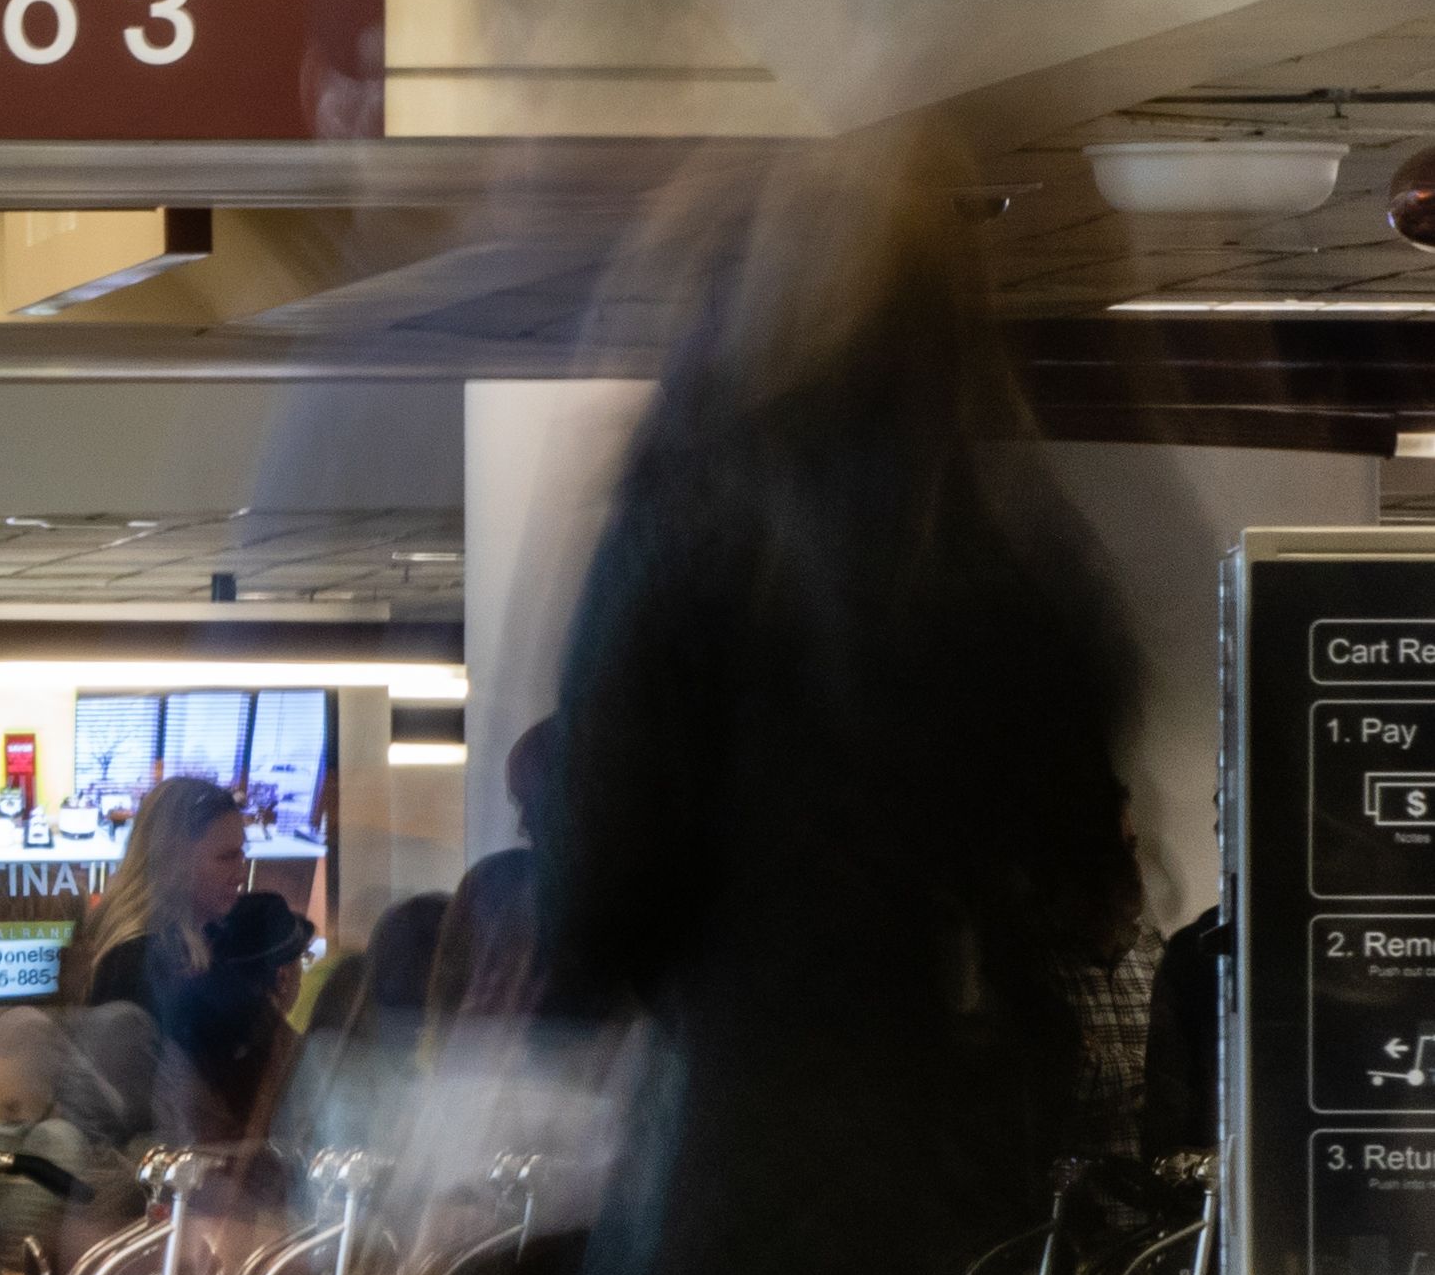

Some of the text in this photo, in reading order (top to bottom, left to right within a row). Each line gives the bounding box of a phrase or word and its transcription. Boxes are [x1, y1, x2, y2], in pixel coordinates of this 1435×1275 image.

[1327, 638, 1390, 664] Cart
[1326, 718, 1418, 750] 1. Pay
[1326, 931, 1435, 957] 2. Rem
[1326, 1144, 1435, 1170] 3. Retu
